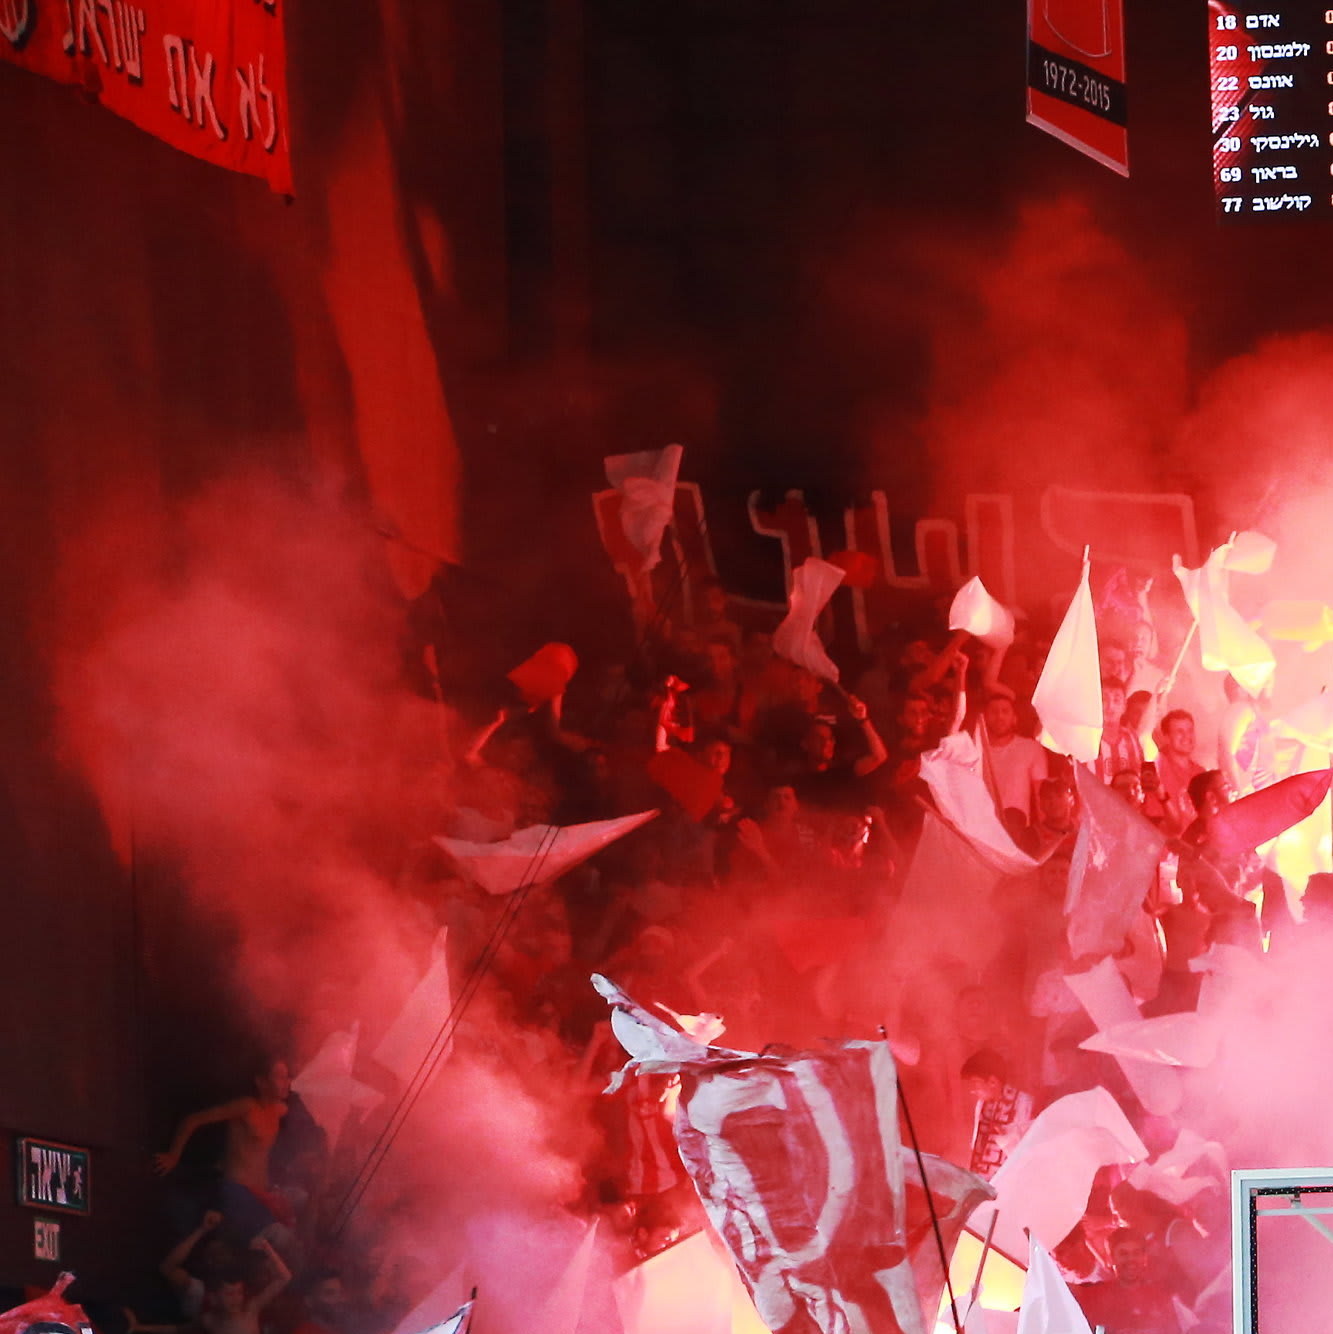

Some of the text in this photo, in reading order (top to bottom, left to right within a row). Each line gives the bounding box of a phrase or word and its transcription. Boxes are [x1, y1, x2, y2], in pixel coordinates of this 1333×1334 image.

[1216, 15, 1237, 31] 18
[1245, 13, 1281, 29] אדם
[1216, 45, 1238, 61] 20
[1043, 59, 1111, 111] 1972-2015
[1217, 76, 1239, 91] 22
[1218, 106, 1240, 122] 23
[1219, 136, 1241, 152] 30
[1220, 167, 1242, 183] 69
[1221, 197, 1243, 213] 77
